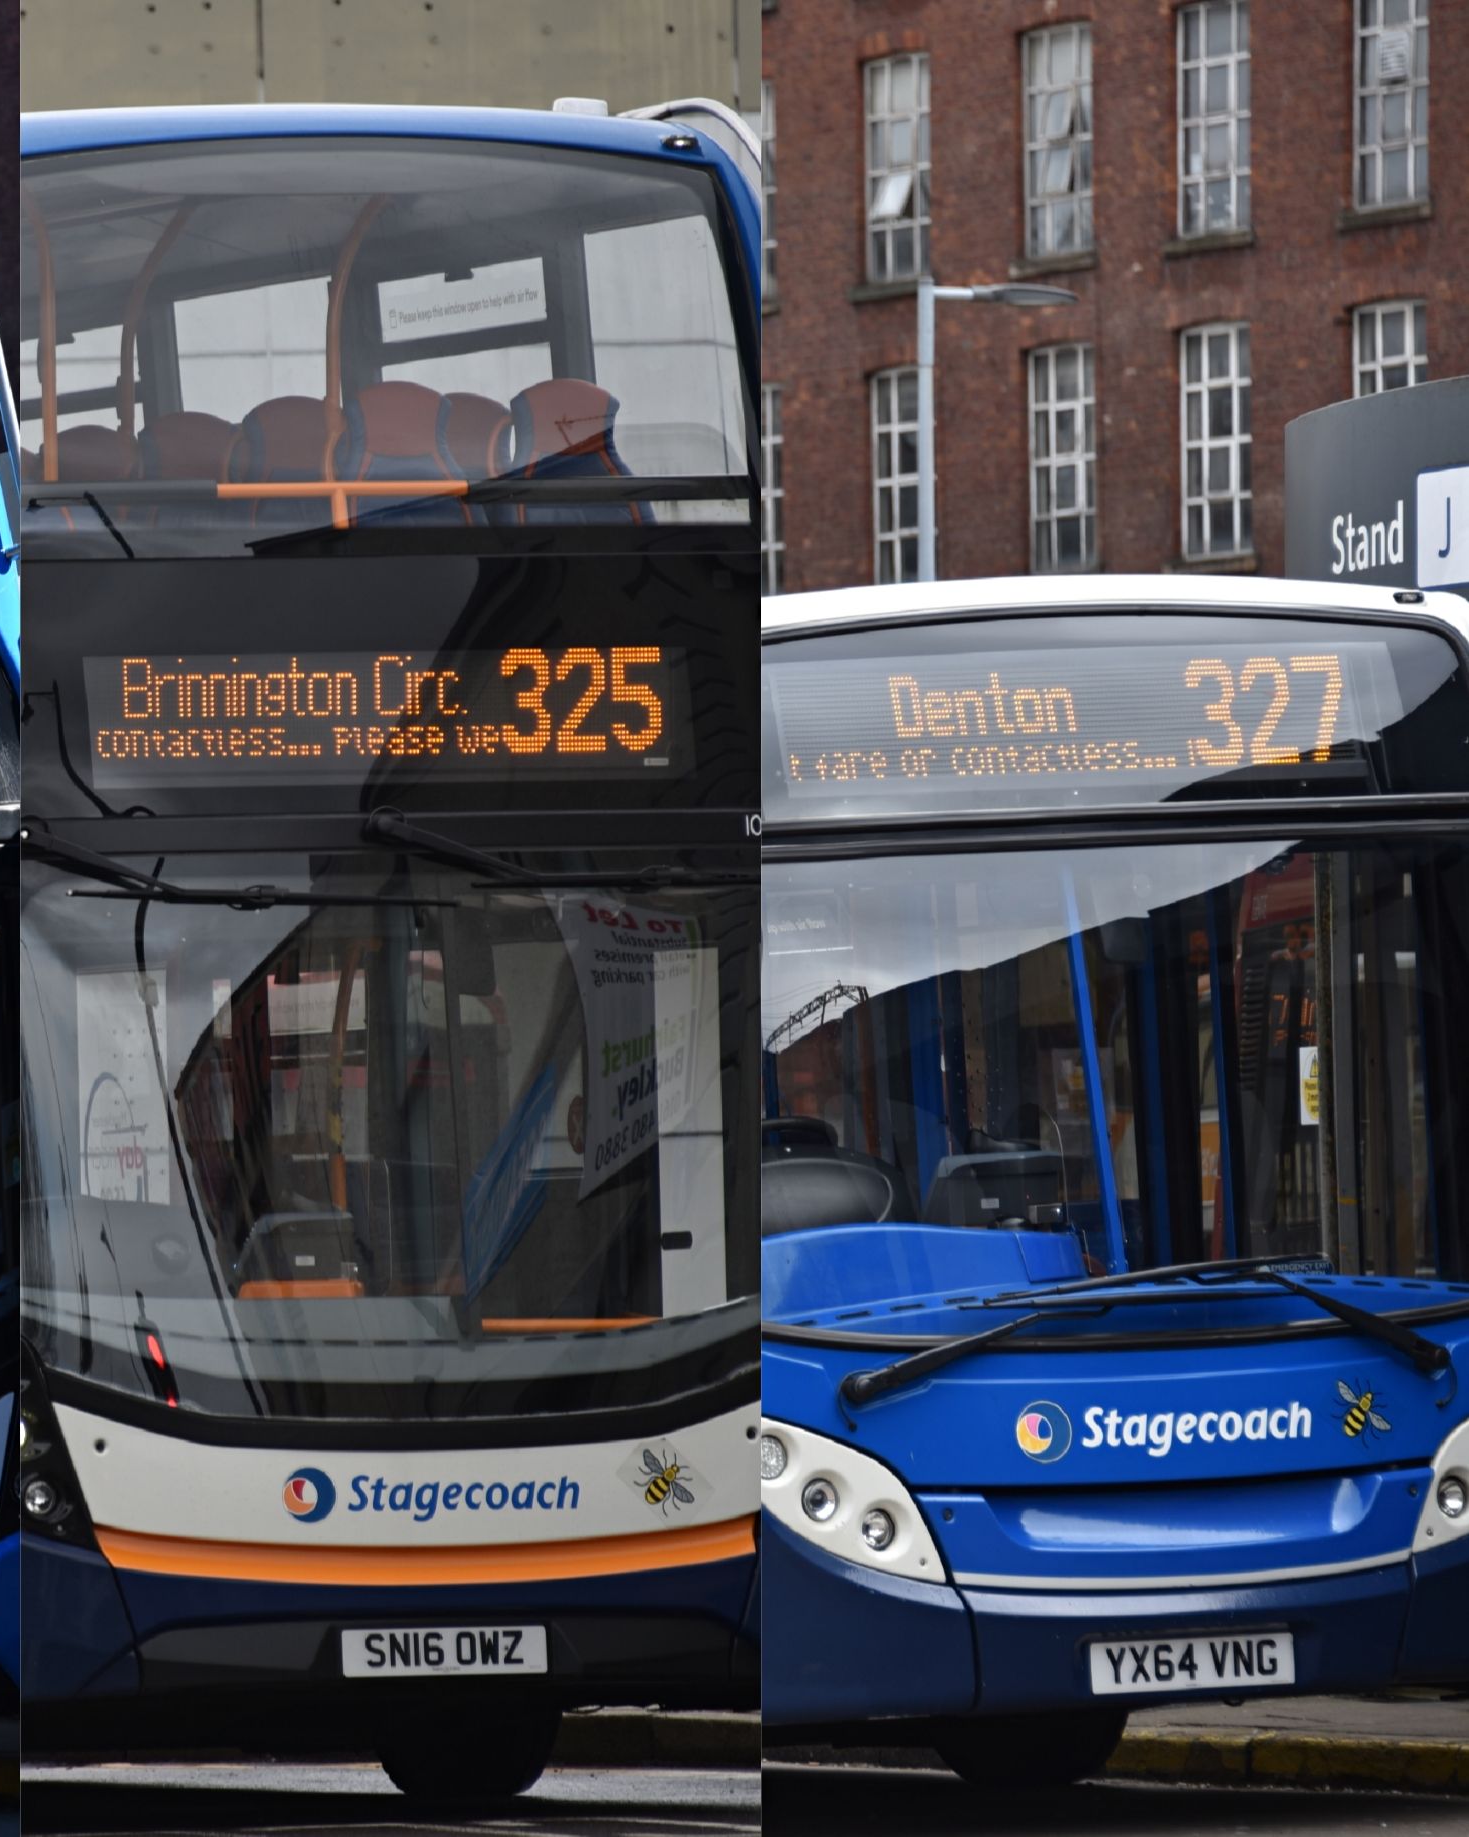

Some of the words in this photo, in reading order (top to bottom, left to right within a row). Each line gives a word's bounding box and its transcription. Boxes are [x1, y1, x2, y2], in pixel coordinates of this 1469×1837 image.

[1332, 500, 1404, 575] Stand
[1438, 496, 1451, 558] J
[122, 655, 359, 719] Brinnington
[373, 654, 469, 717] Circ.
[499, 645, 663, 753] 325
[888, 672, 1077, 738] Denton
[1184, 654, 1343, 767] 327
[1082, 1401, 1312, 1458] Stagecoach
[347, 1474, 580, 1522] Stagecoach
[364, 1632, 445, 1668] SN16
[456, 1630, 525, 1666] OWZ
[1105, 1643, 1199, 1685] YX64
[1209, 1638, 1278, 1678] VNG
